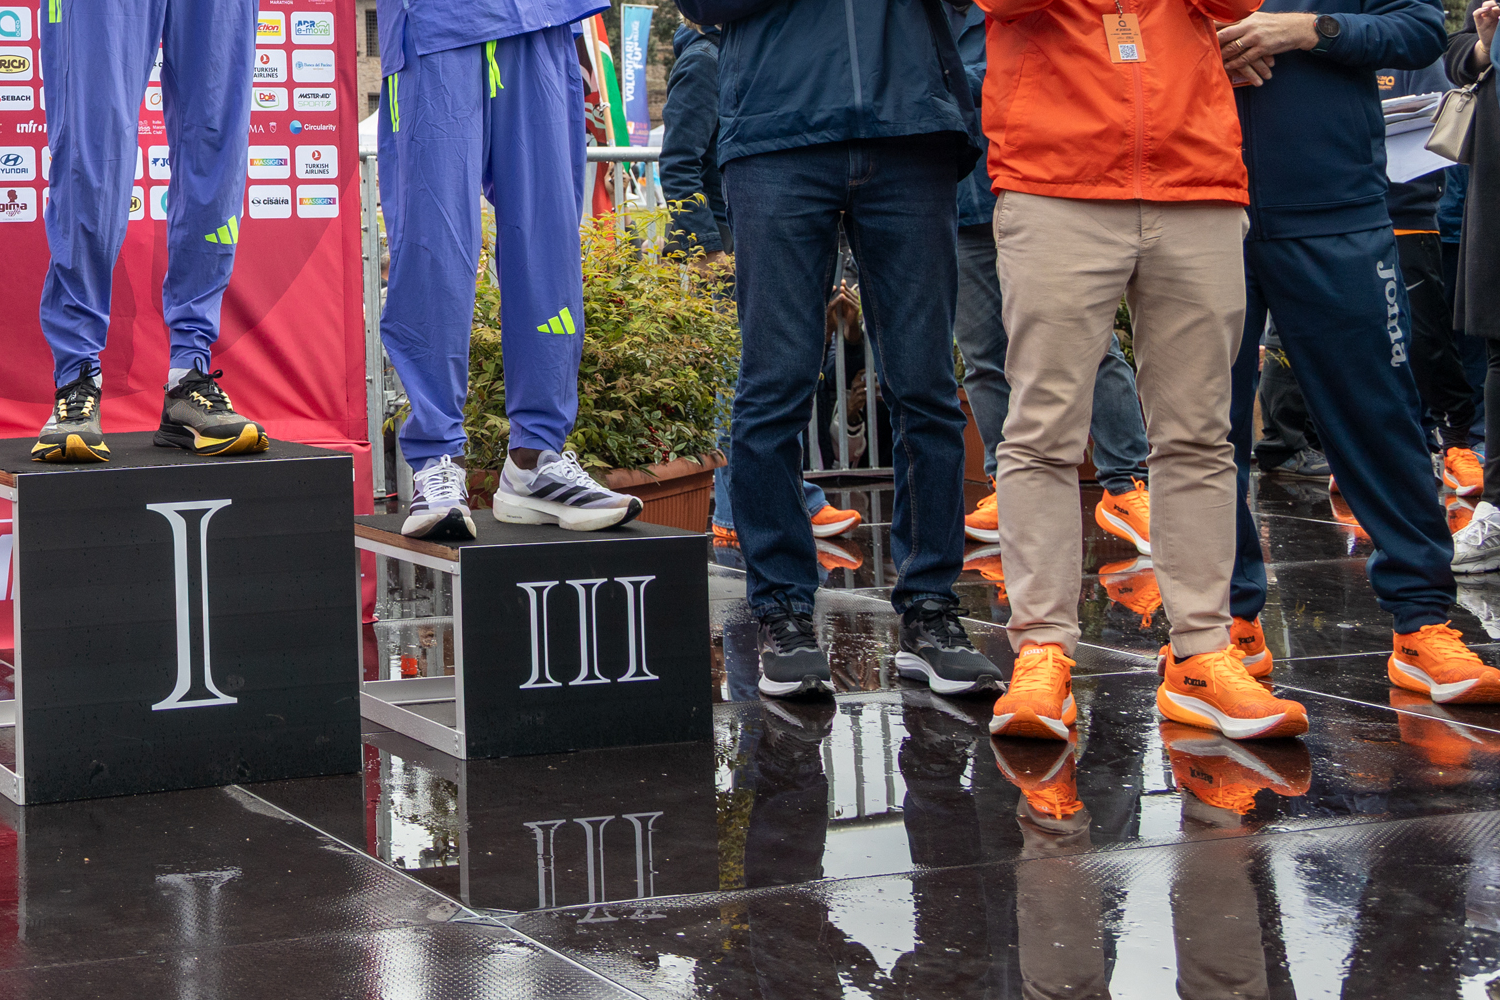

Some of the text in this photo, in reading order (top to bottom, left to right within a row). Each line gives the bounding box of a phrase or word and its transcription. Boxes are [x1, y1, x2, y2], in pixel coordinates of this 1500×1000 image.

[625, 39, 636, 103] VOLONTARI
[304, 123, 336, 132] Circularity
[1376, 260, 1407, 368] Joma
[145, 498, 238, 711] I
[516, 575, 659, 689] III
[1183, 676, 1207, 687] Joma
